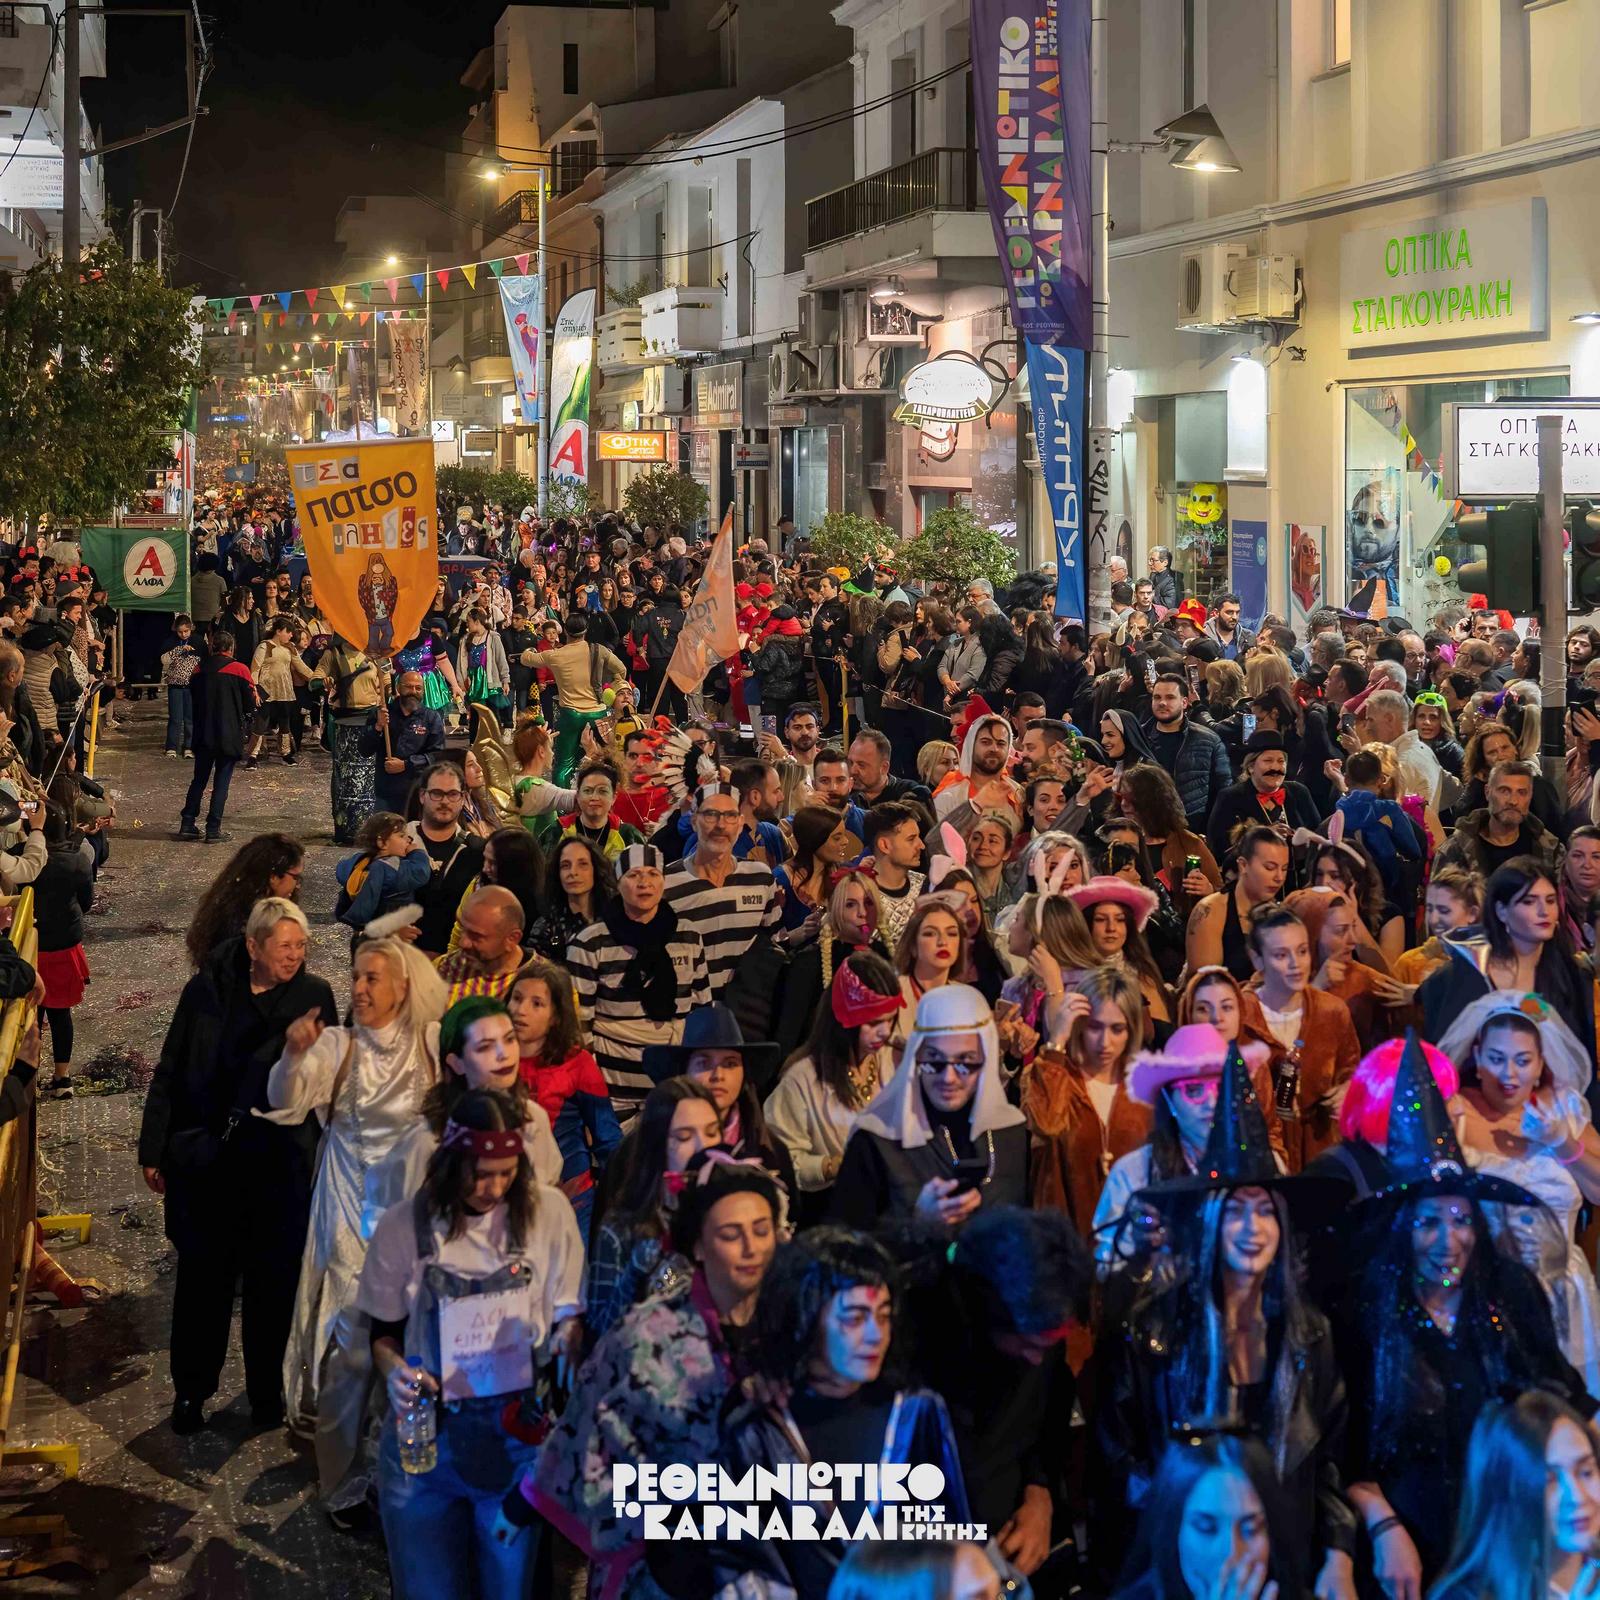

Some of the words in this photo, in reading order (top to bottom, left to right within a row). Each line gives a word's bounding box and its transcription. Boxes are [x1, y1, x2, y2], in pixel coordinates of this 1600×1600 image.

[1385, 229, 1473, 277] ΟΠΤΙΚΑ
[1352, 279, 1513, 334] ΣΤΑΓΚΟΥΡΑΚΗ
[708, 377, 737, 411] Admiral
[133, 577, 165, 587] ΑΛΦΑ
